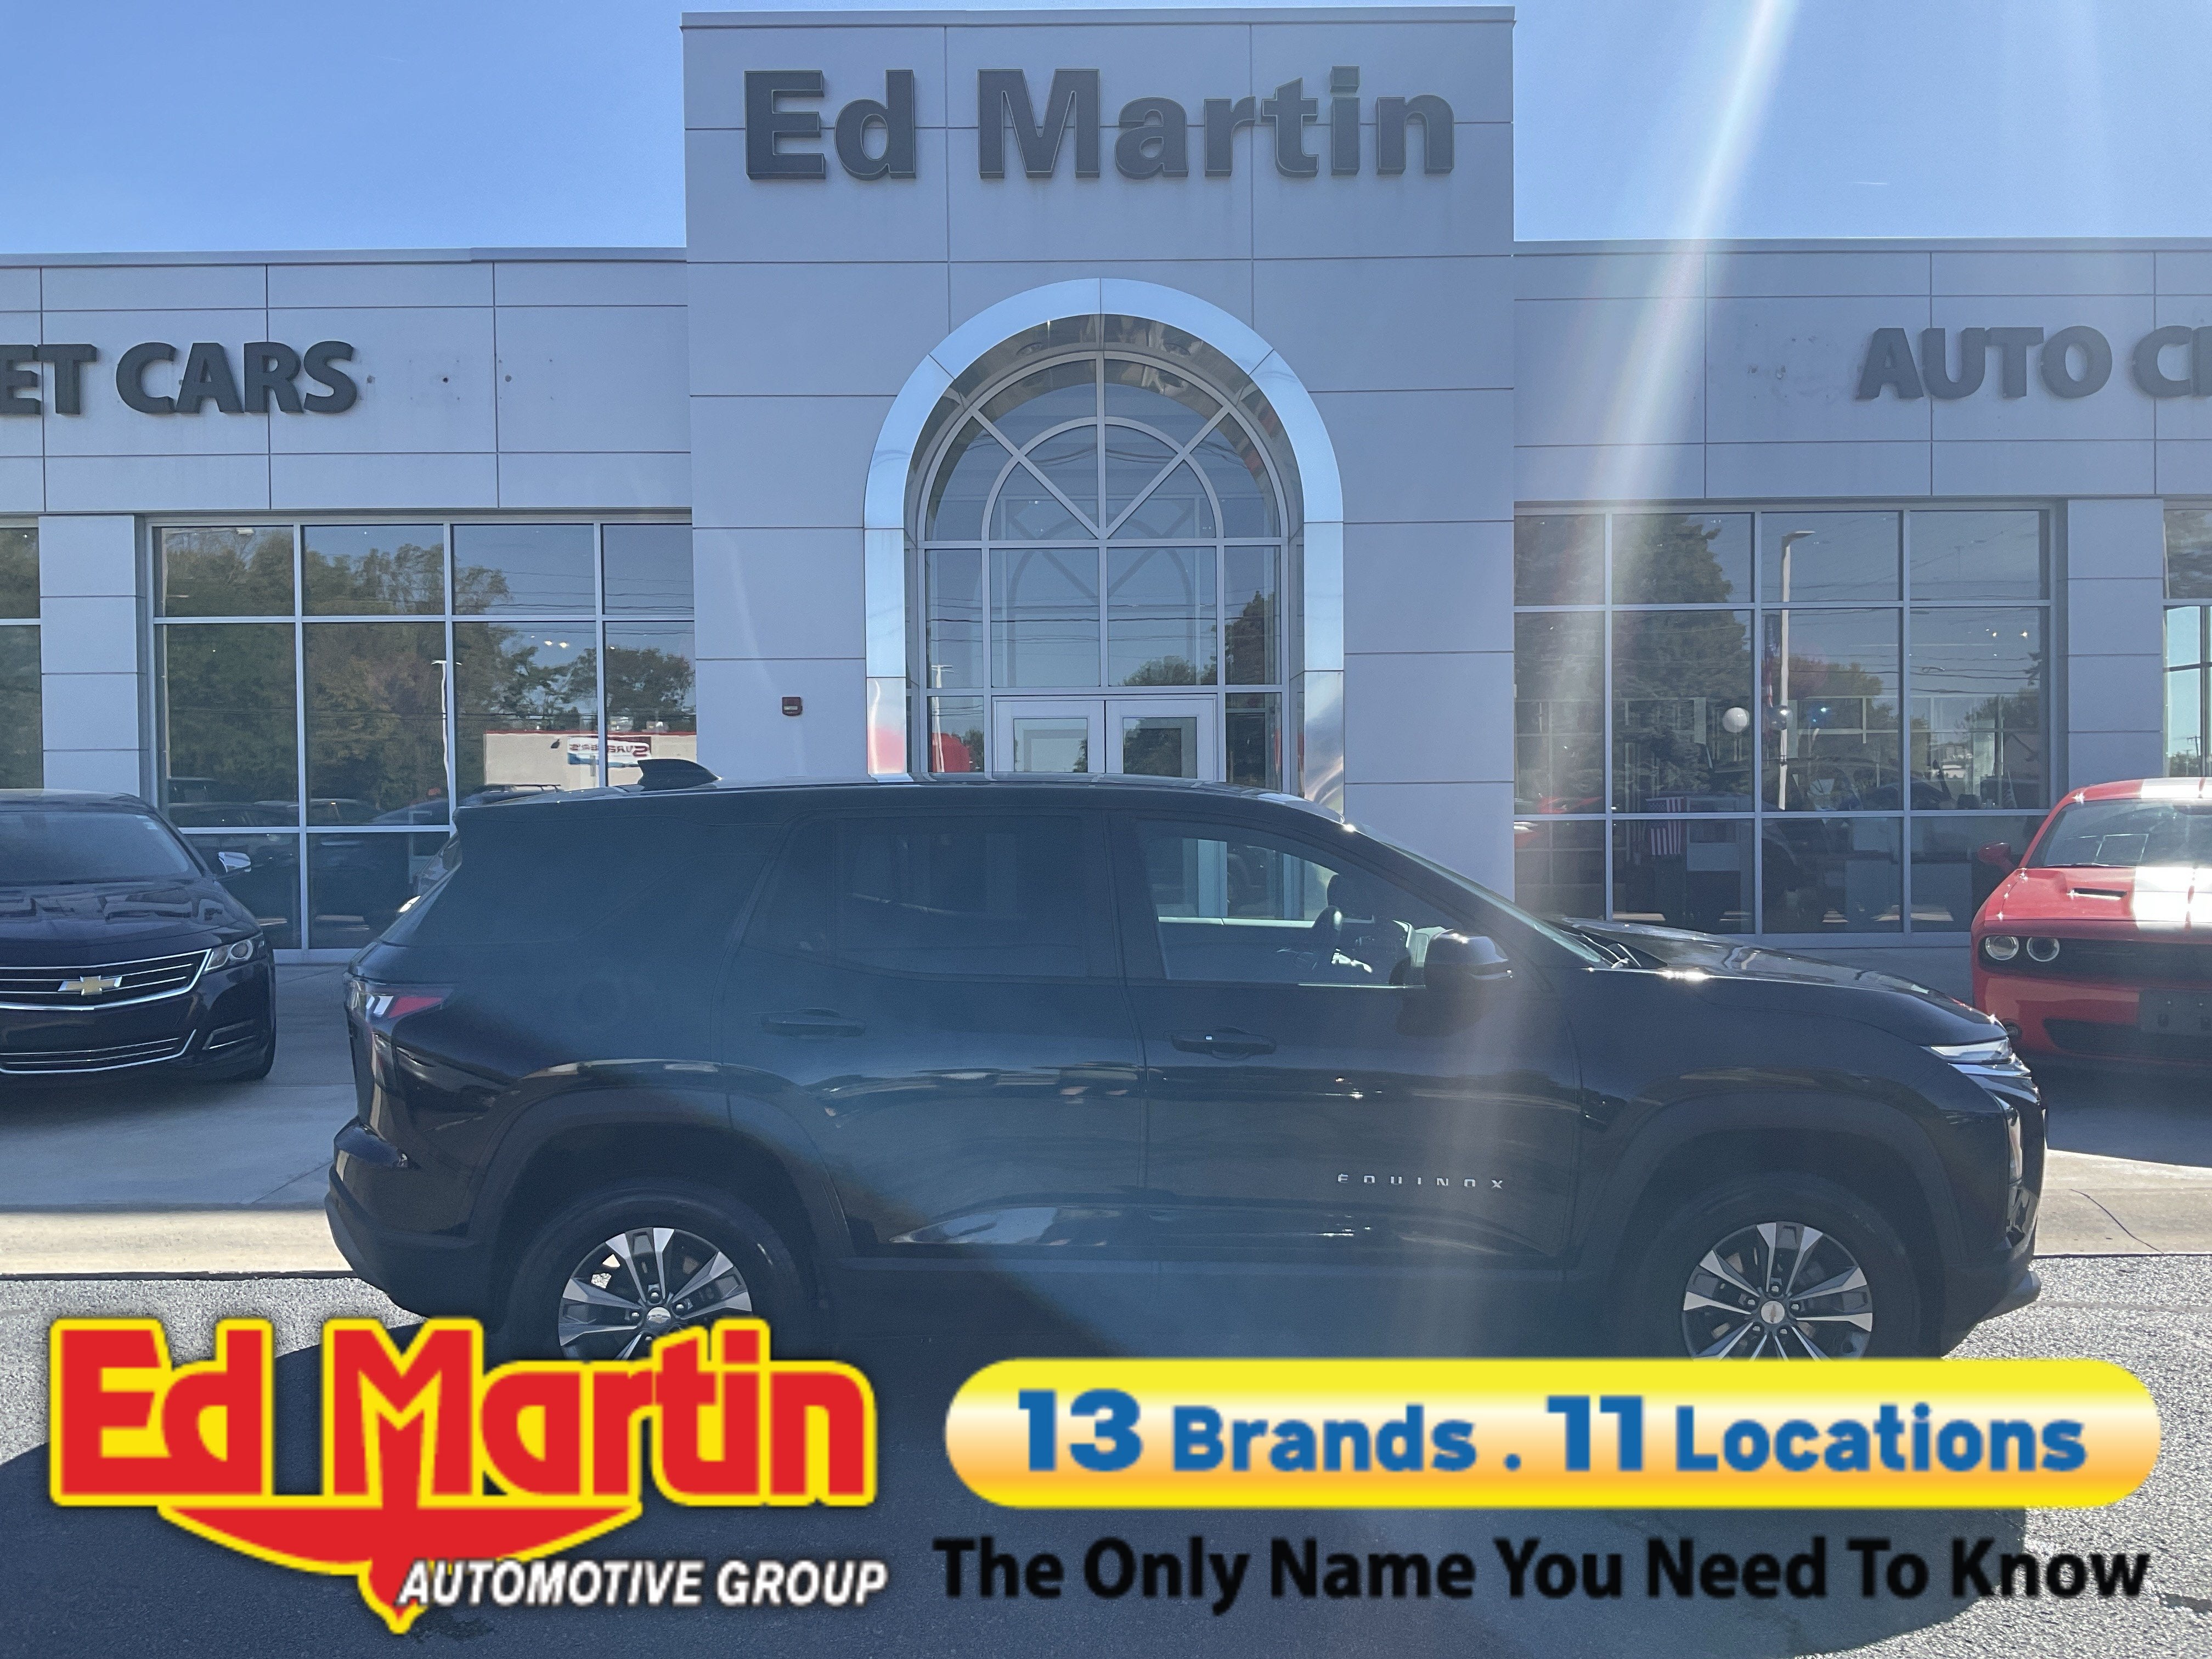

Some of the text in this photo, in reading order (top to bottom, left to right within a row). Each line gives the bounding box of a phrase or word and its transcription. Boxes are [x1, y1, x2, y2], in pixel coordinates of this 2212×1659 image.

[744, 66, 1455, 180] Ed Martin
[0, 341, 357, 415] ET CARS
[1855, 325, 2113, 400] AUTO
[1337, 1173, 1503, 1189] EQUINOX
